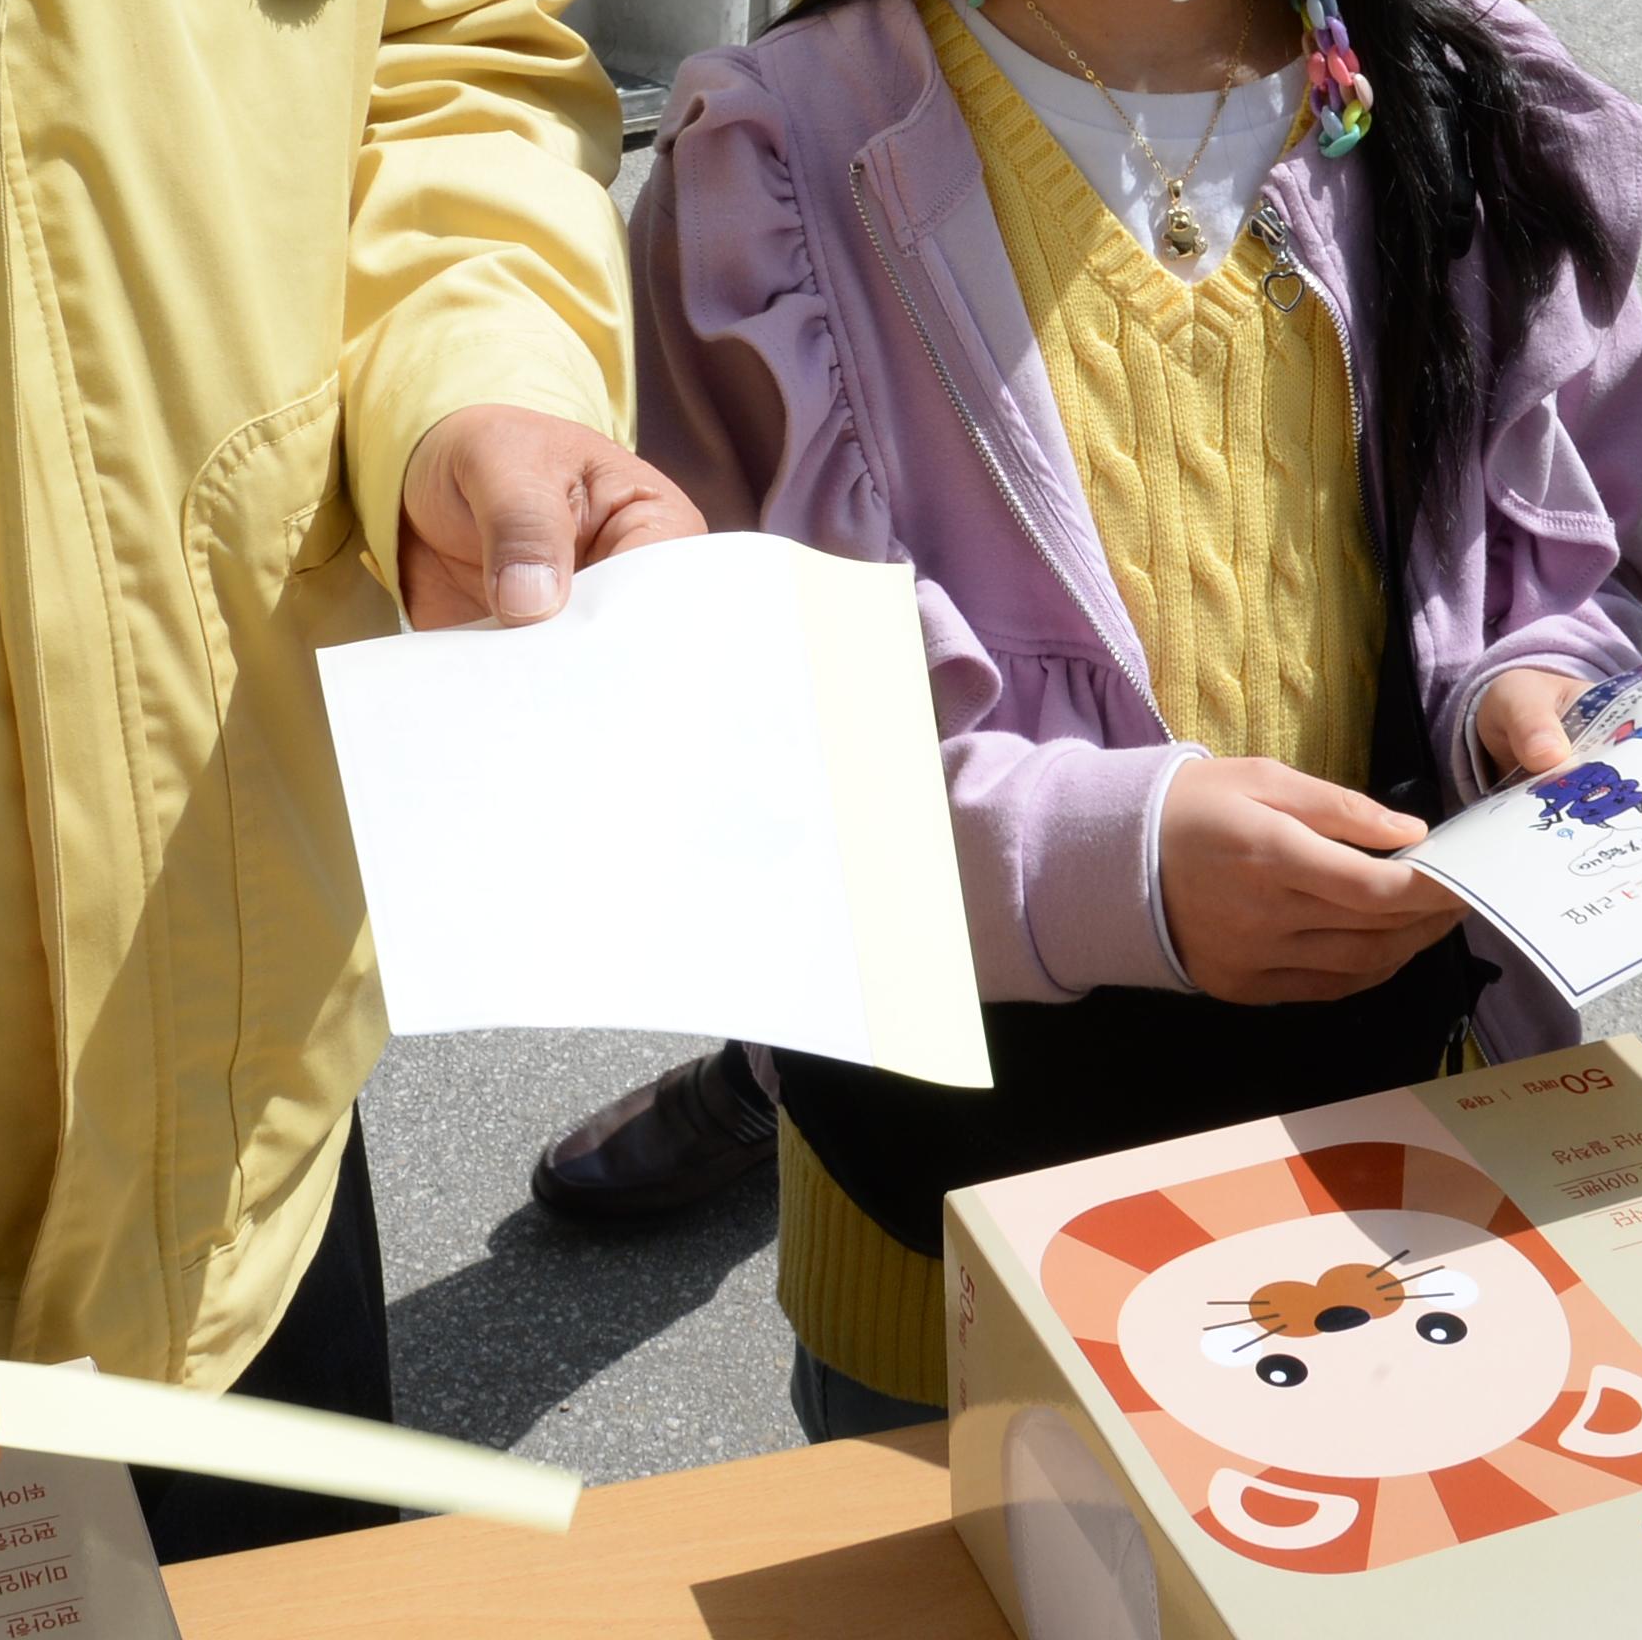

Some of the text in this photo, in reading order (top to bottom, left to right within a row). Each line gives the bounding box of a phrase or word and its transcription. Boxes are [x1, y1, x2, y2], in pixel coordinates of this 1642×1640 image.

[1457, 1068, 1614, 1110] 50매입 대형
[1551, 1141, 1611, 1165] 밀착성
[1561, 1172, 1639, 1200] 이어밴드
[7, 1604, 82, 1639] 편안한
